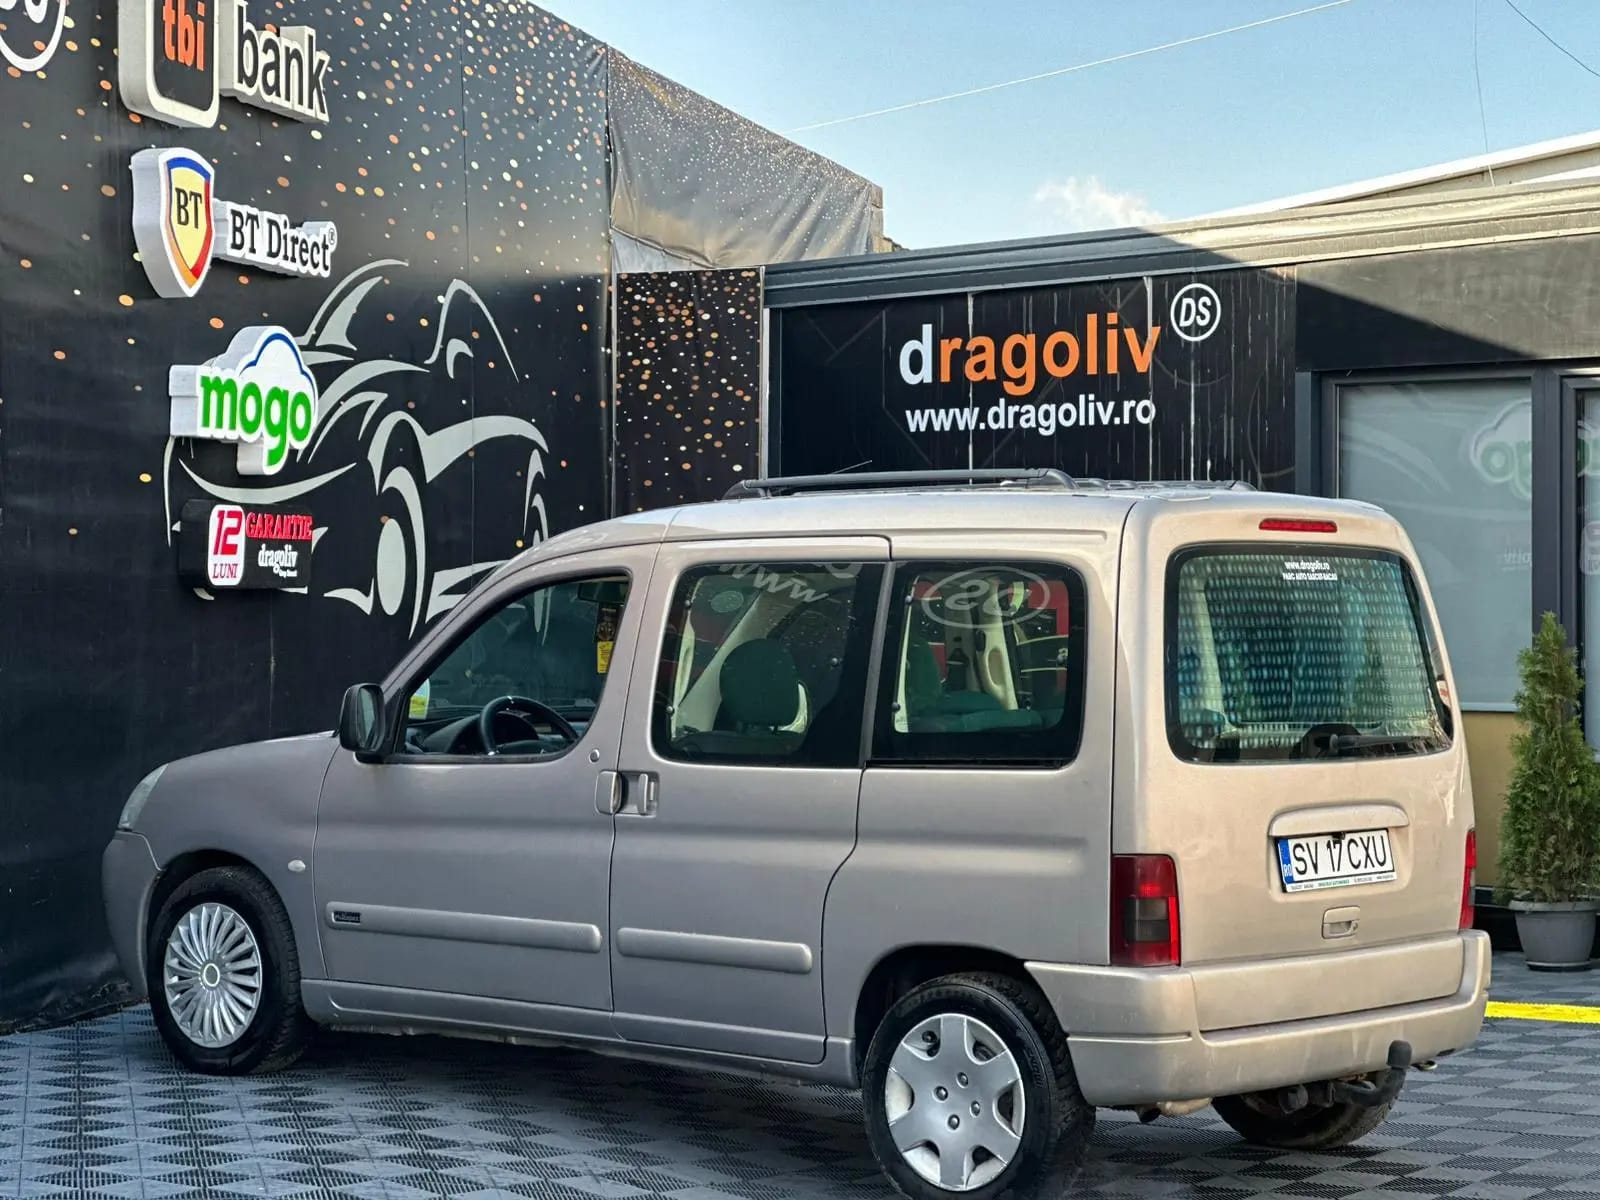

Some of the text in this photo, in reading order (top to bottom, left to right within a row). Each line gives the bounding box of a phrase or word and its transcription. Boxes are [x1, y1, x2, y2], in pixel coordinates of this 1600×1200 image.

[163, 0, 327, 115] tbi bank
[174, 187, 203, 230] BT
[230, 208, 259, 254] BT
[1179, 296, 1211, 328] DS
[899, 312, 1161, 397] dragoliv
[200, 375, 312, 467] mogo
[905, 394, 1156, 436] www.dragoliv.ro
[213, 510, 243, 556] 12
[245, 512, 313, 541] GARANTIE
[212, 563, 239, 580] LUNI
[257, 543, 298, 574] dragoliv
[1283, 863, 1293, 877] RO
[1292, 840, 1319, 875] SV
